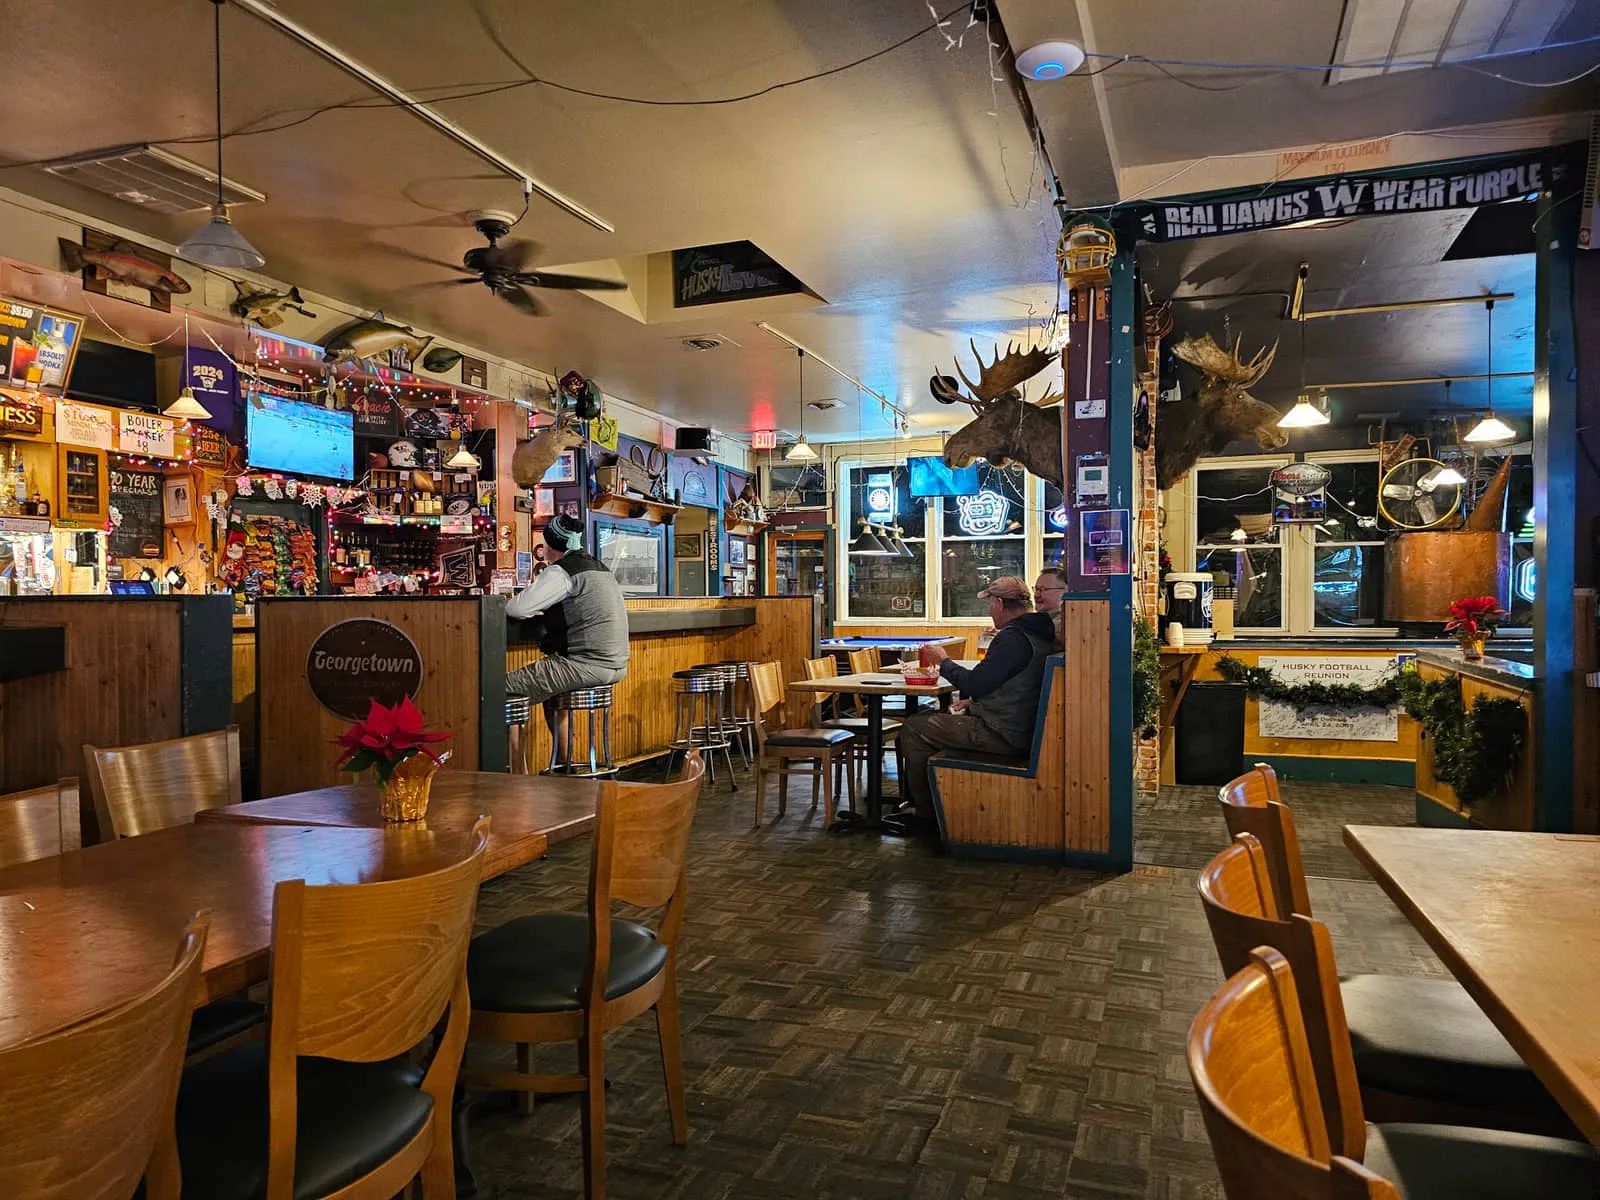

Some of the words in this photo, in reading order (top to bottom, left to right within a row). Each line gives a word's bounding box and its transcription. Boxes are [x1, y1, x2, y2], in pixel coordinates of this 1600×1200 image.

[1165, 205, 1217, 238] REAL
[1222, 190, 1310, 231] DAWGS
[1372, 177, 1446, 211] WEAR
[1450, 162, 1543, 206] PURPLE
[192, 365, 224, 381] 2024
[127, 415, 162, 430] BOILER
[755, 432, 772, 448] EXIT
[127, 473, 156, 489] YEAR
[315, 650, 413, 675] Georgetown
[1282, 663, 1316, 671] HUSKY
[1319, 663, 1372, 671] FOOTBALL
